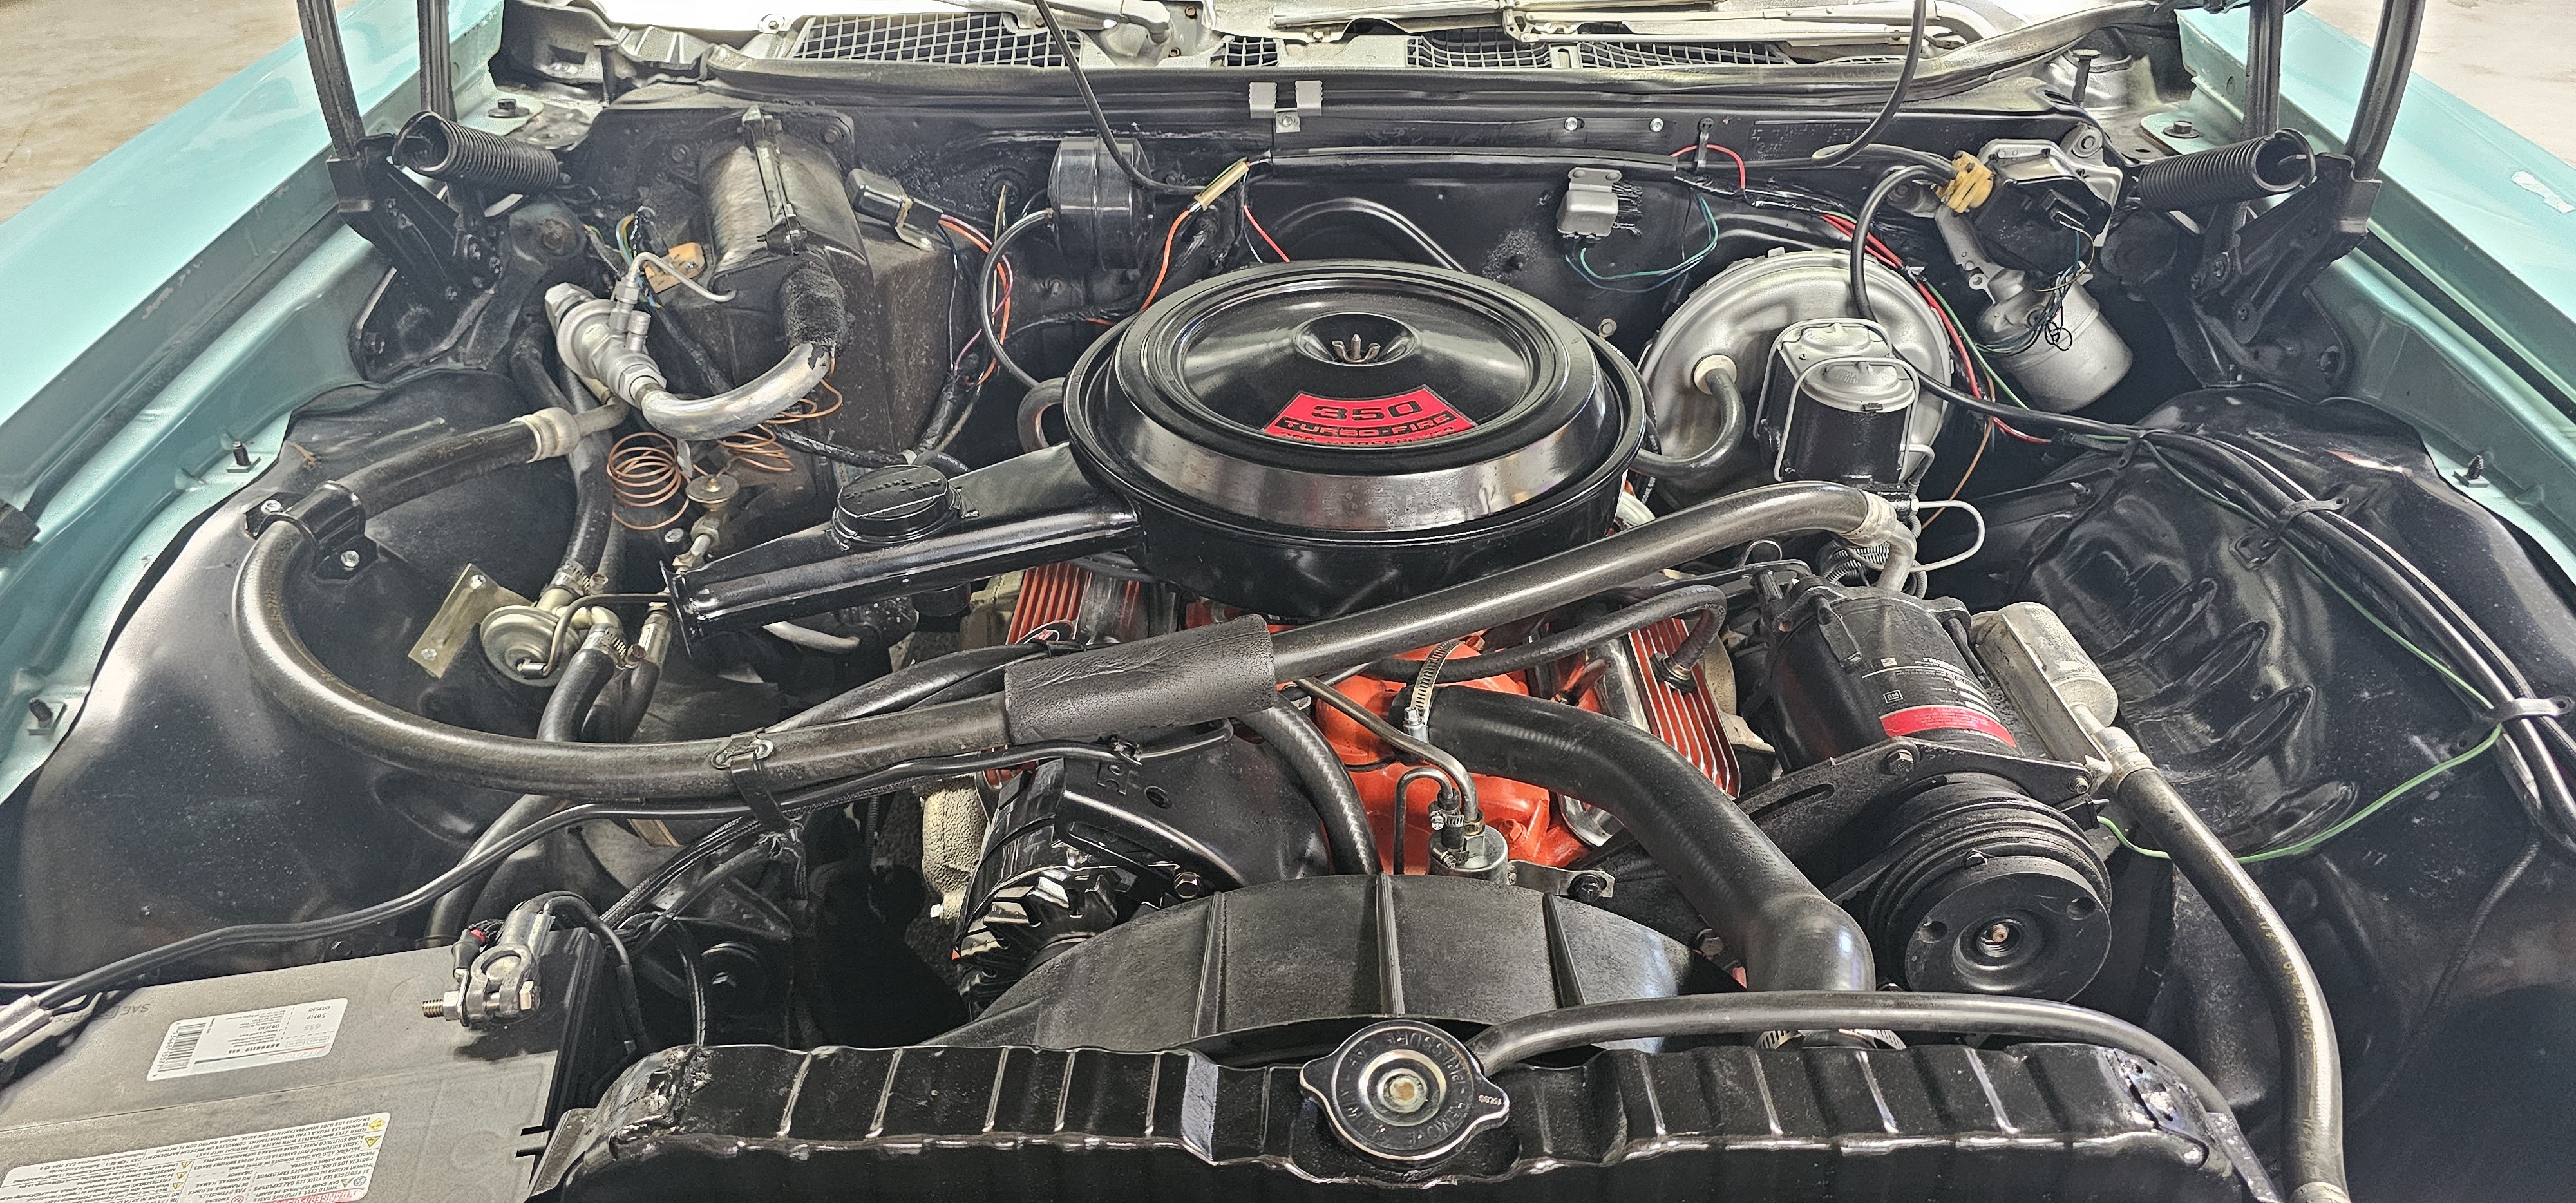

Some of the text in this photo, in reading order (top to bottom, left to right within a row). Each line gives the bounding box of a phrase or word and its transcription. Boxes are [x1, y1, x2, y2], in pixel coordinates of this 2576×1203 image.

[1311, 400, 1423, 421] 350
[1284, 413, 1451, 437] TURBO-FIRE
[120, 1003, 151, 1016] SAE
